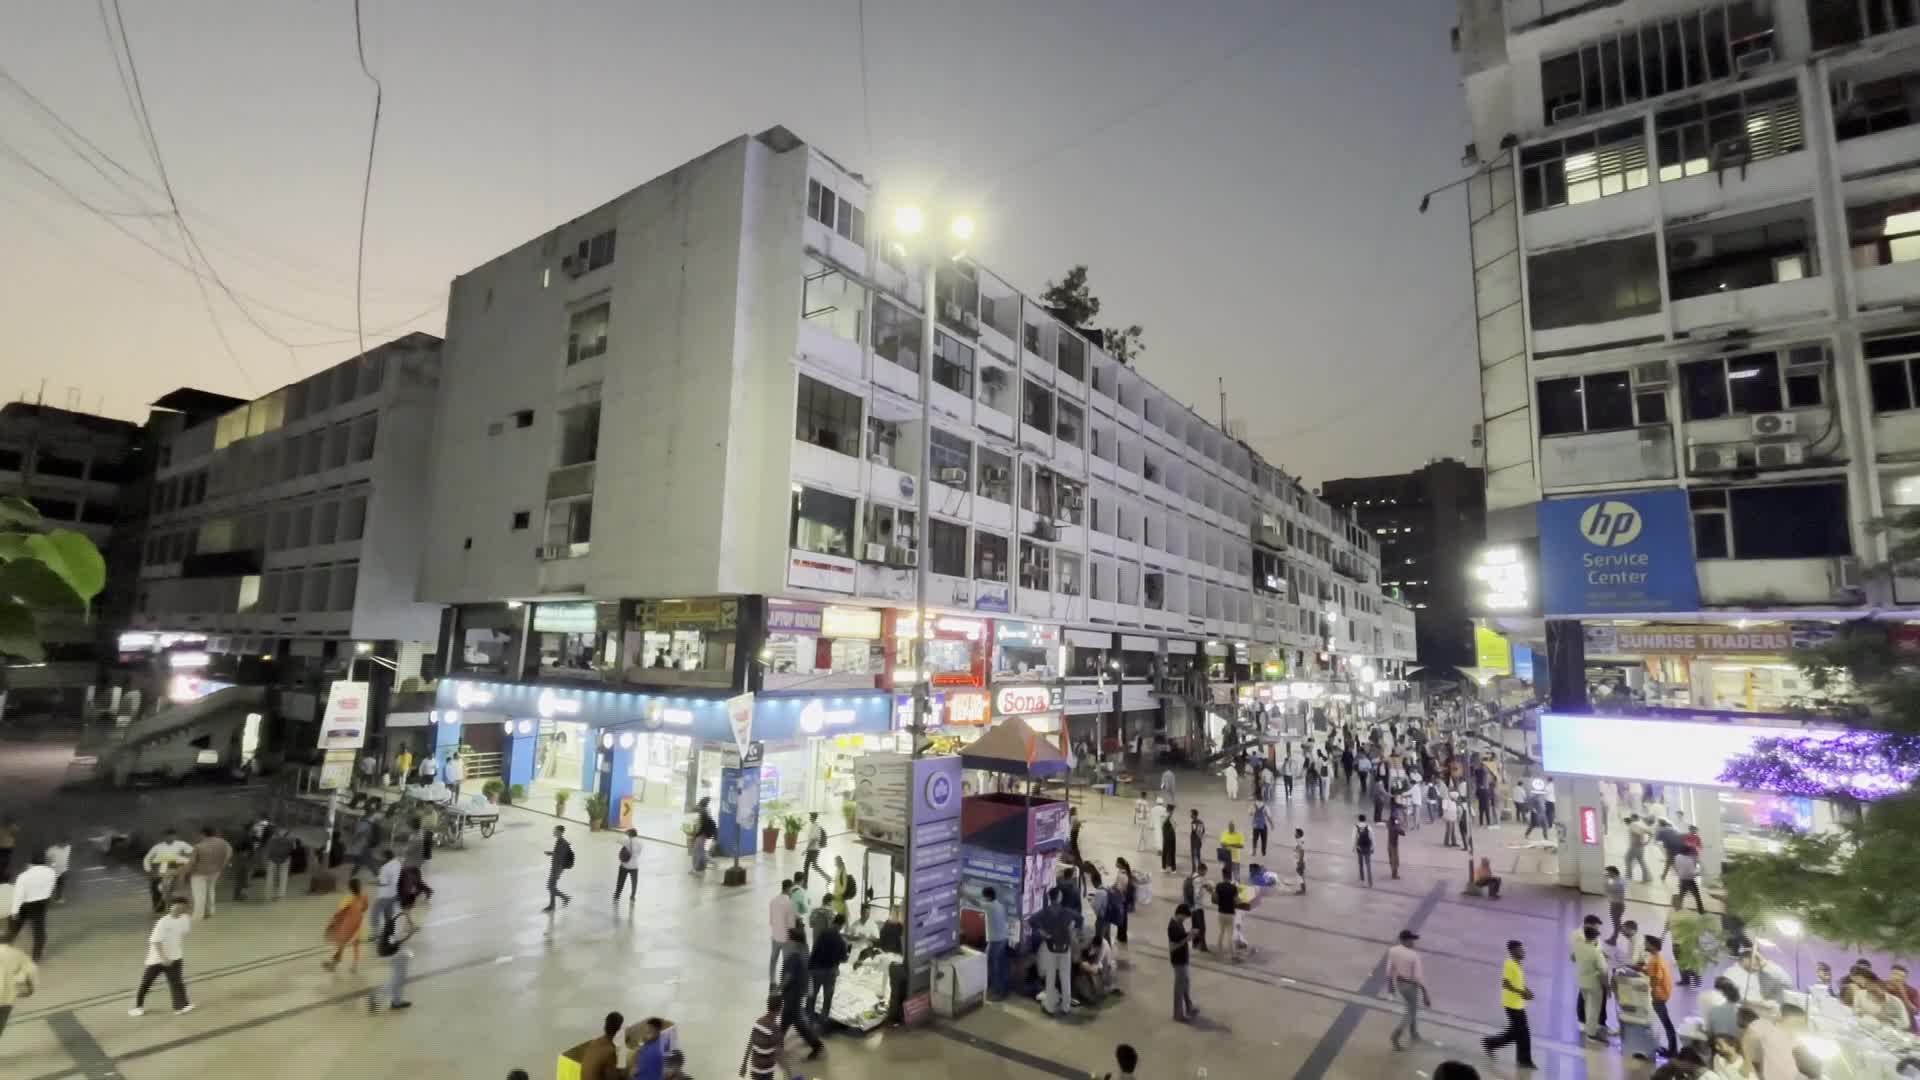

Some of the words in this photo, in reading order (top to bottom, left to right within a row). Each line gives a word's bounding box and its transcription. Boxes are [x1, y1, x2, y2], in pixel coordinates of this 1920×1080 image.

[1587, 501, 1635, 548] hp
[1583, 552, 1649, 568] Service
[1587, 570, 1649, 585] Center
[1618, 632, 1697, 649] SUNRISE
[1701, 632, 1788, 650] TRADERS
[1003, 691, 1050, 713] Sona
